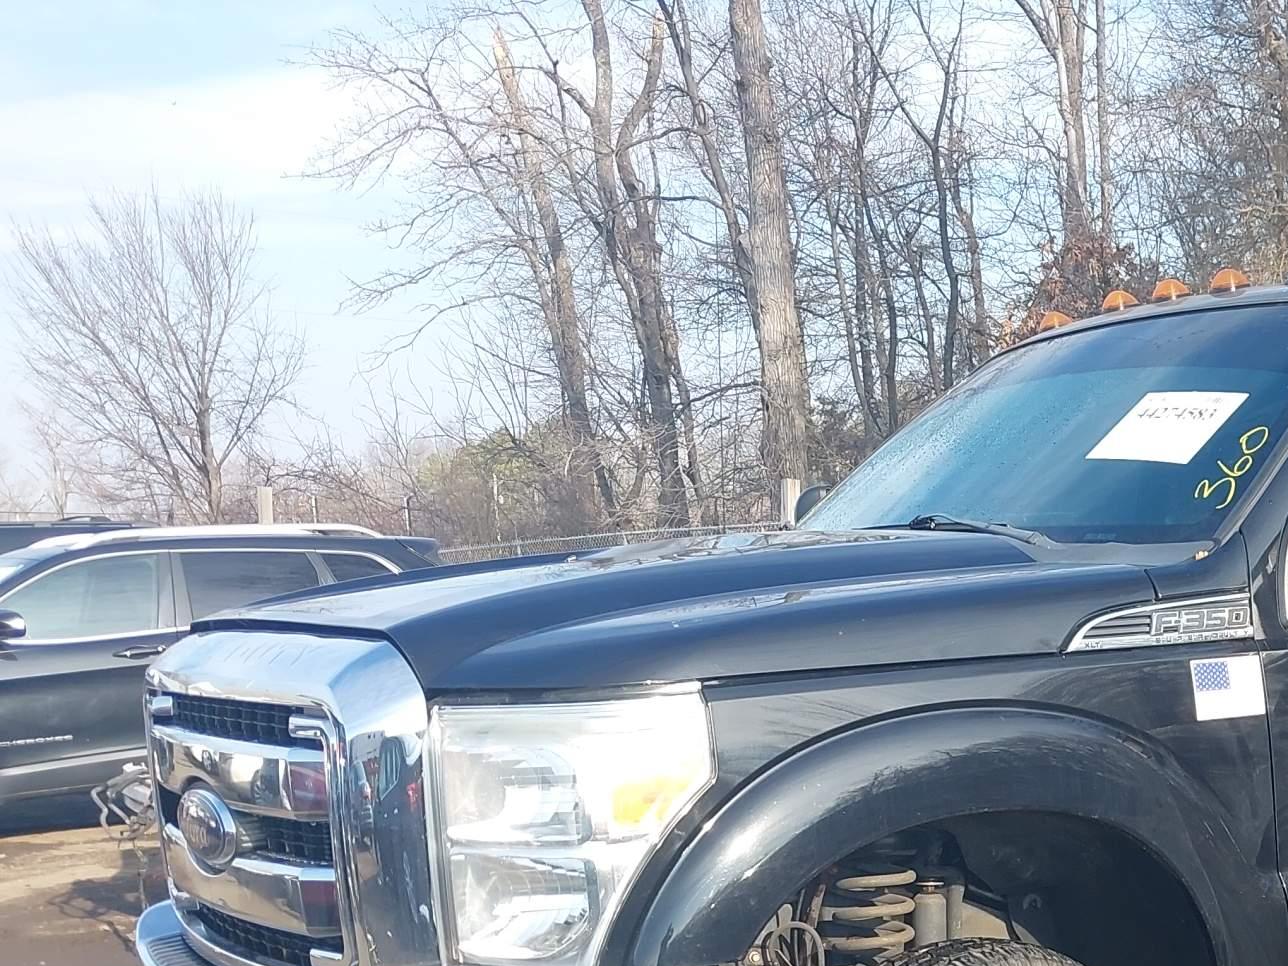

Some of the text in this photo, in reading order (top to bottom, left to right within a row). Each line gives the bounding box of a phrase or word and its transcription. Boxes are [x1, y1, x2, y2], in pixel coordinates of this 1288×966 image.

[1194, 426, 1269, 509] 360
[1152, 607, 1249, 636] F-350
[1084, 641, 1101, 649] XLT
